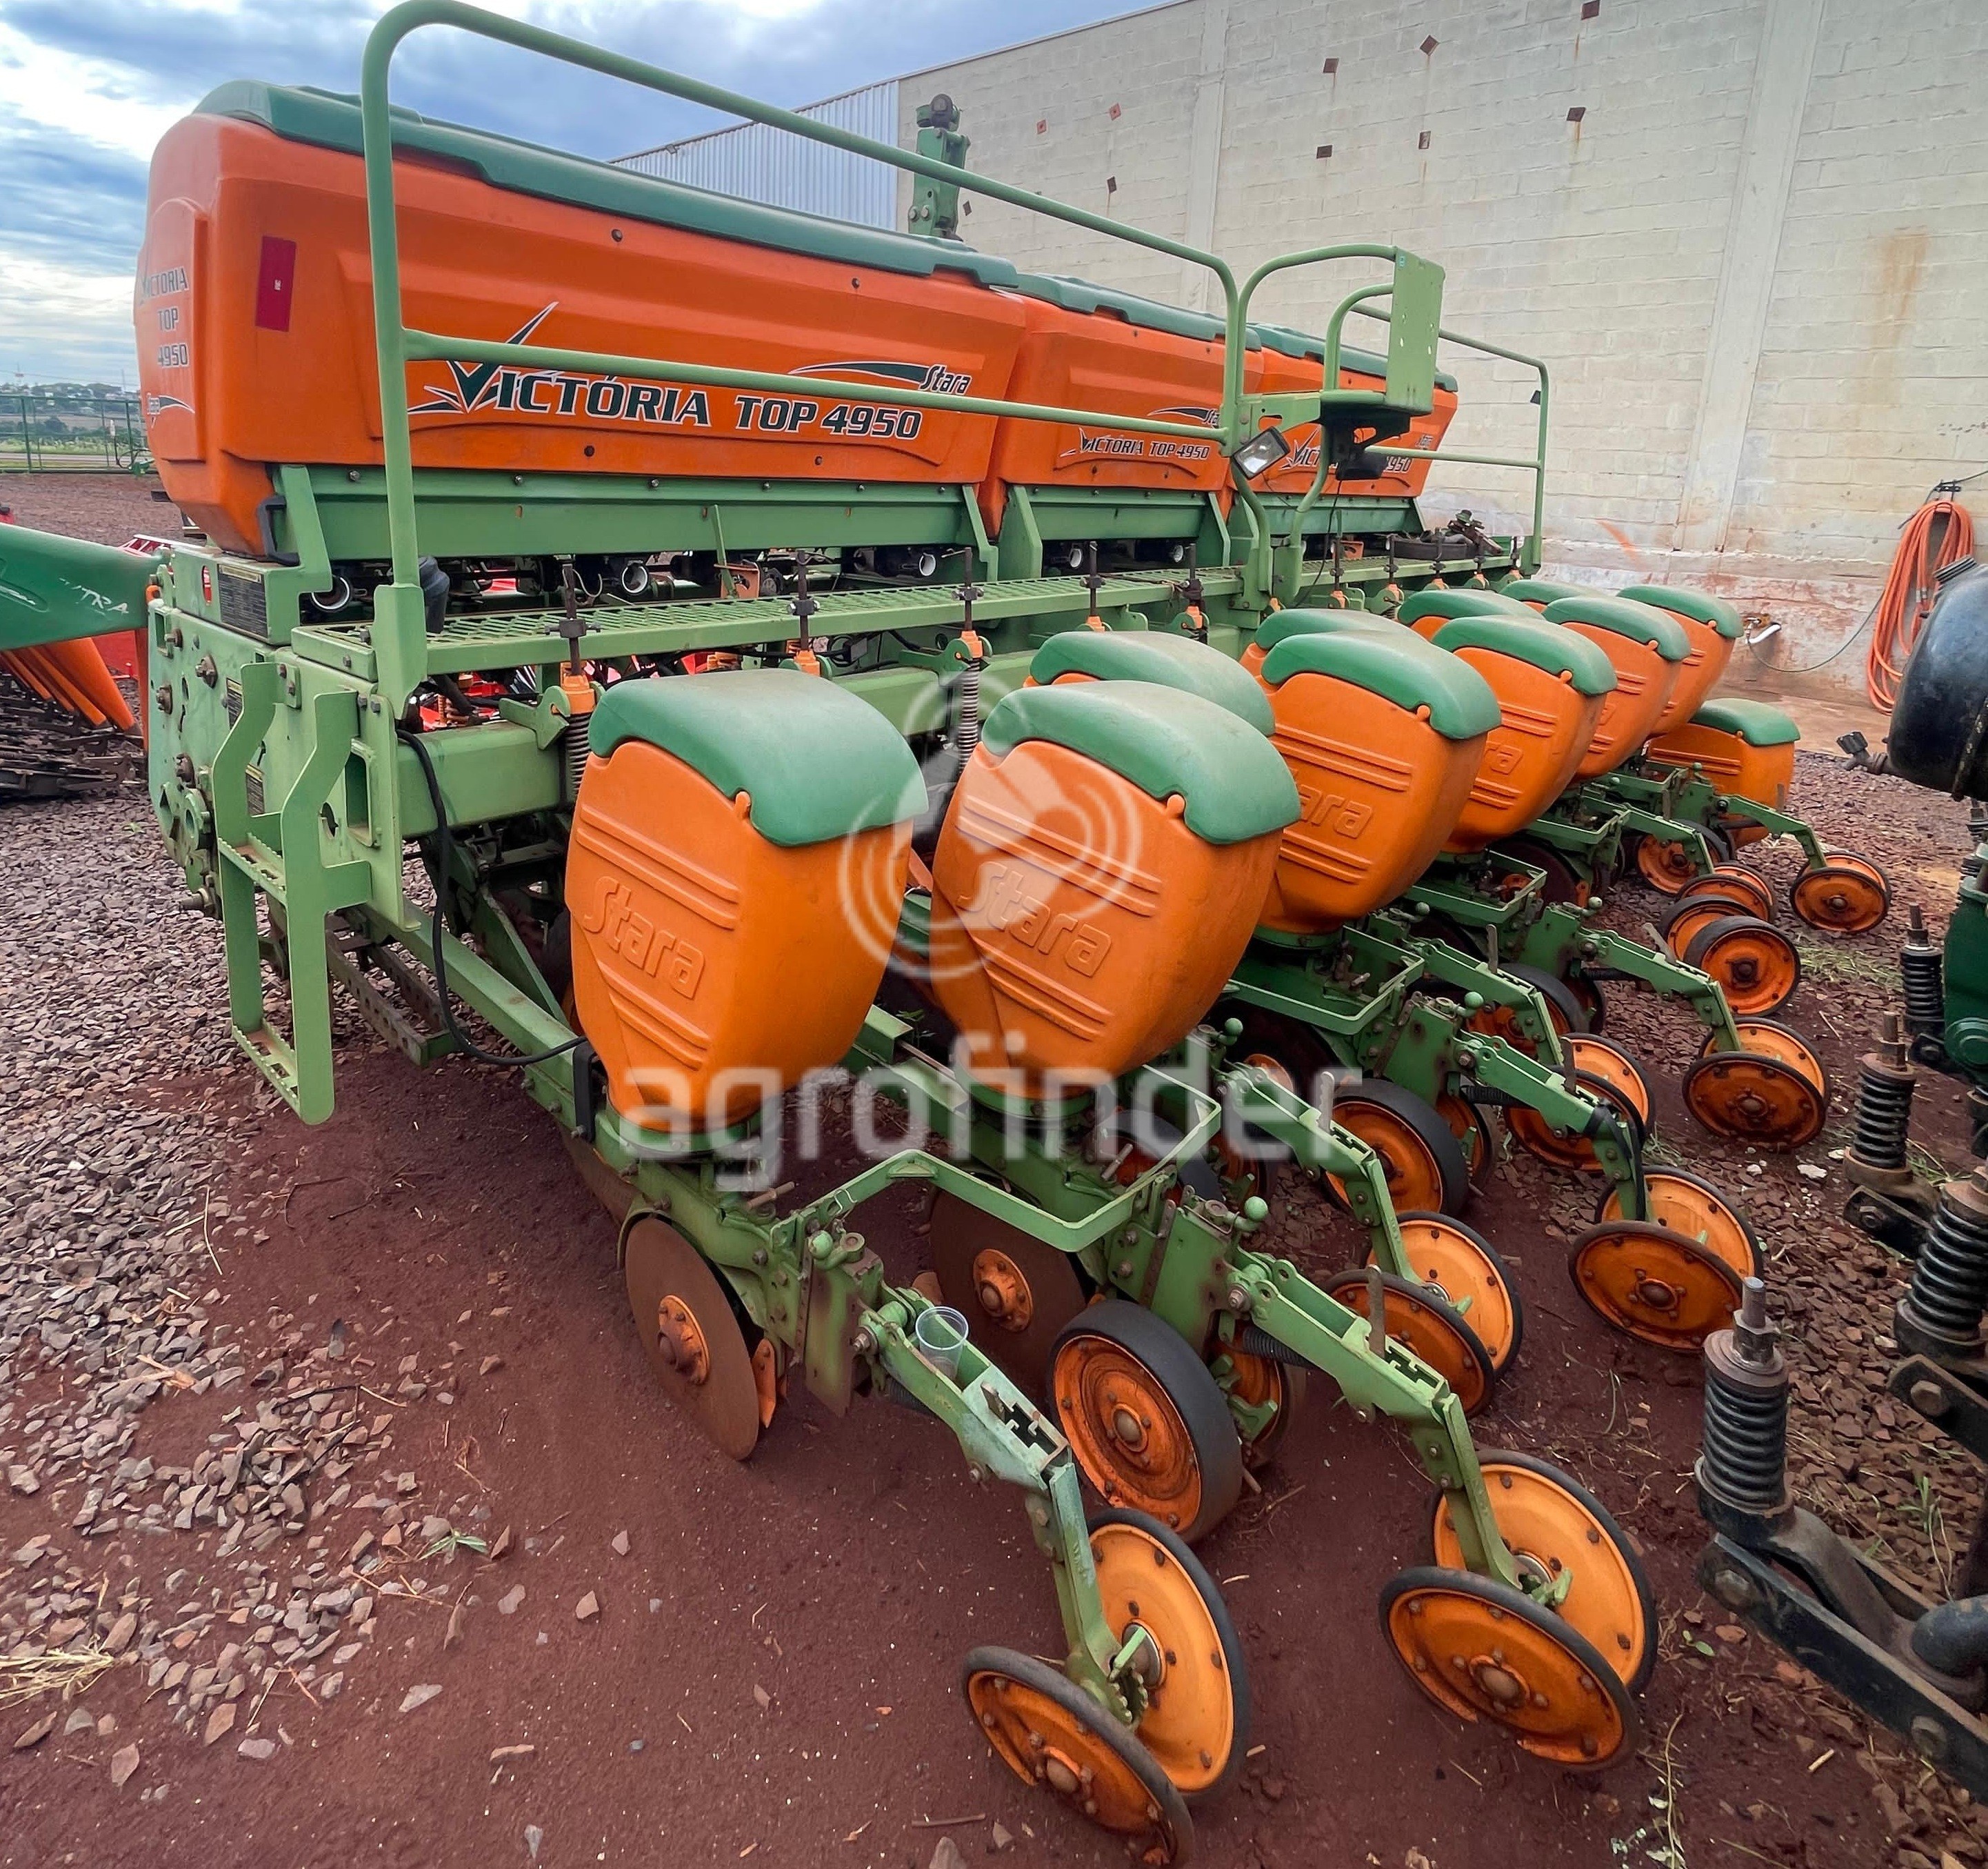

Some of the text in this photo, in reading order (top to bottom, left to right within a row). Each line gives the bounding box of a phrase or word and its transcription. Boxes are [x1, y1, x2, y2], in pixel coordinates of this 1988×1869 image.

[157, 307, 179, 332] TOP
[157, 343, 189, 368] 4950
[918, 364, 972, 395] Stara
[735, 394, 818, 432] TOP
[821, 403, 923, 440] 4950
[1149, 440, 1176, 457] TOP
[1176, 444, 1210, 460] 4950
[1383, 456, 1413, 474] 950
[956, 861, 1112, 978] Stara
[583, 875, 705, 1001] Stara
